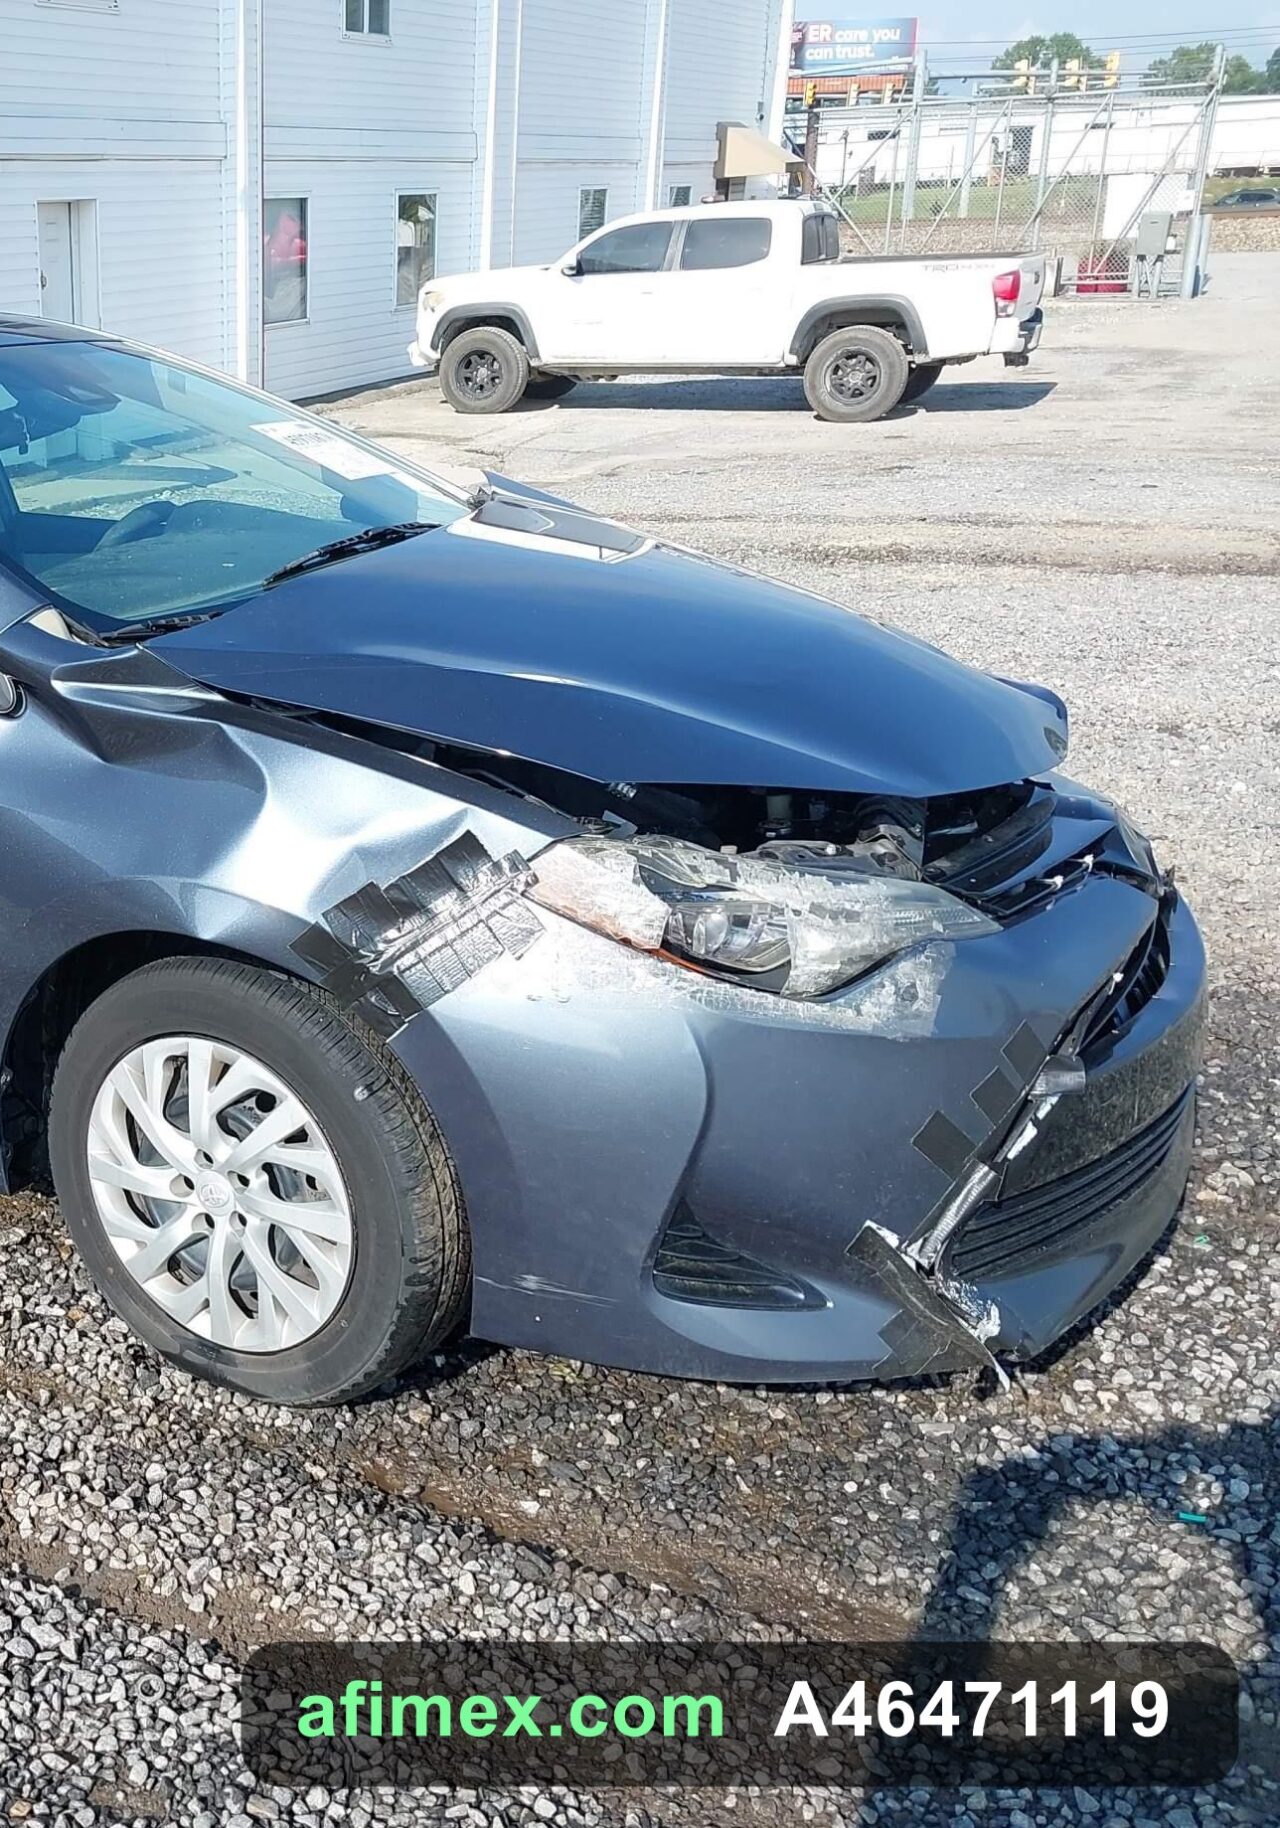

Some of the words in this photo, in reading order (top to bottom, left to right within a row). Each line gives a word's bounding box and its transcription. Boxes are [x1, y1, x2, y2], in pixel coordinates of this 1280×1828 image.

[808, 24, 832, 41] ER
[835, 29, 868, 42] care
[872, 28, 900, 45] you
[805, 46, 833, 60] can
[835, 44, 875, 59] trust.
